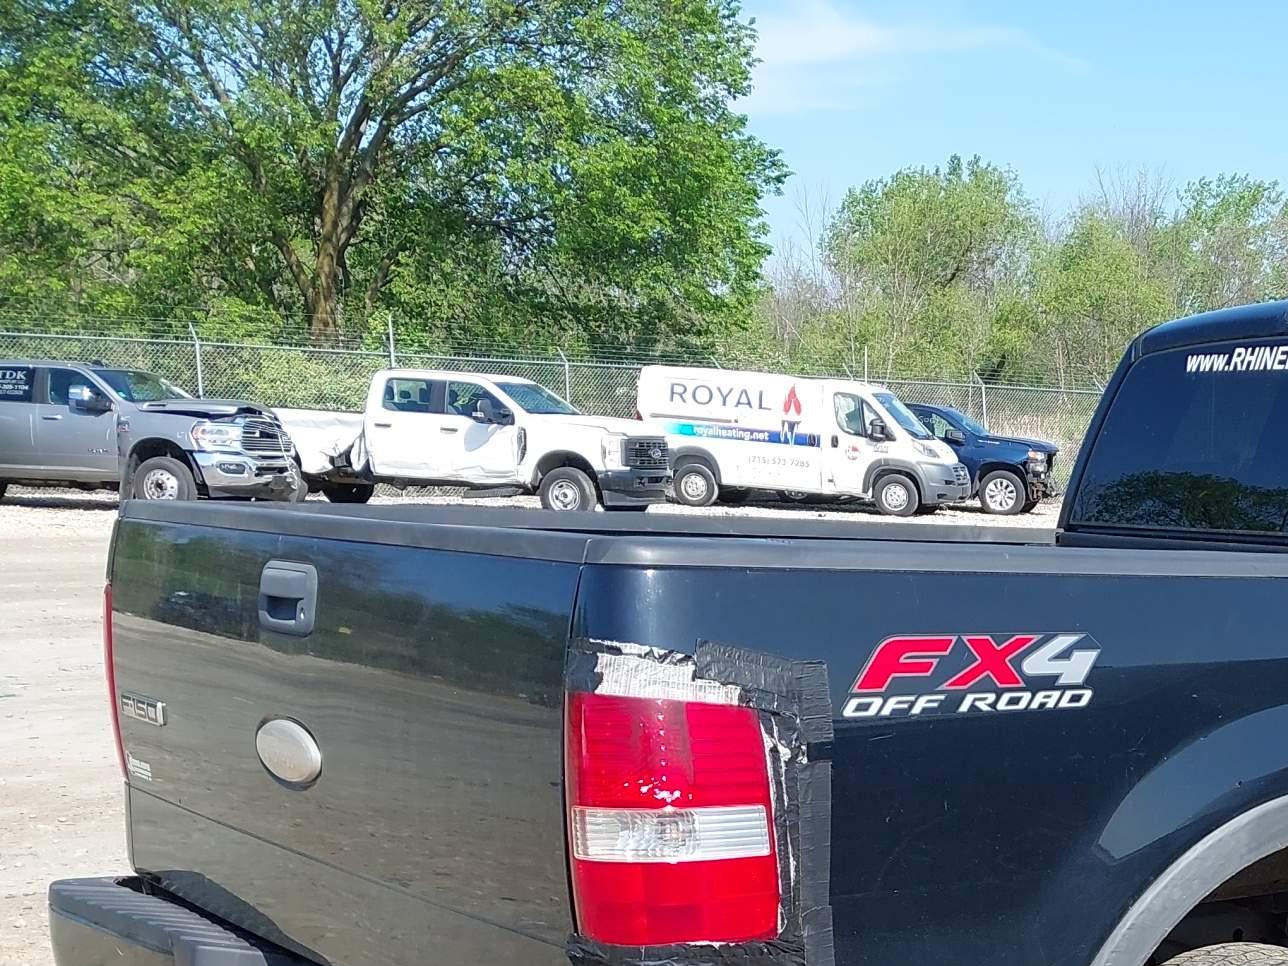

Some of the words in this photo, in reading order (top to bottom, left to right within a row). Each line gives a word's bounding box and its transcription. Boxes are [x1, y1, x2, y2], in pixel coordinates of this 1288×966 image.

[669, 382, 772, 411] ROYAL
[693, 425, 770, 441] royalheating.net
[852, 634, 1102, 693] FX4
[842, 693, 946, 718] OFF
[957, 689, 1093, 713] ROAD
